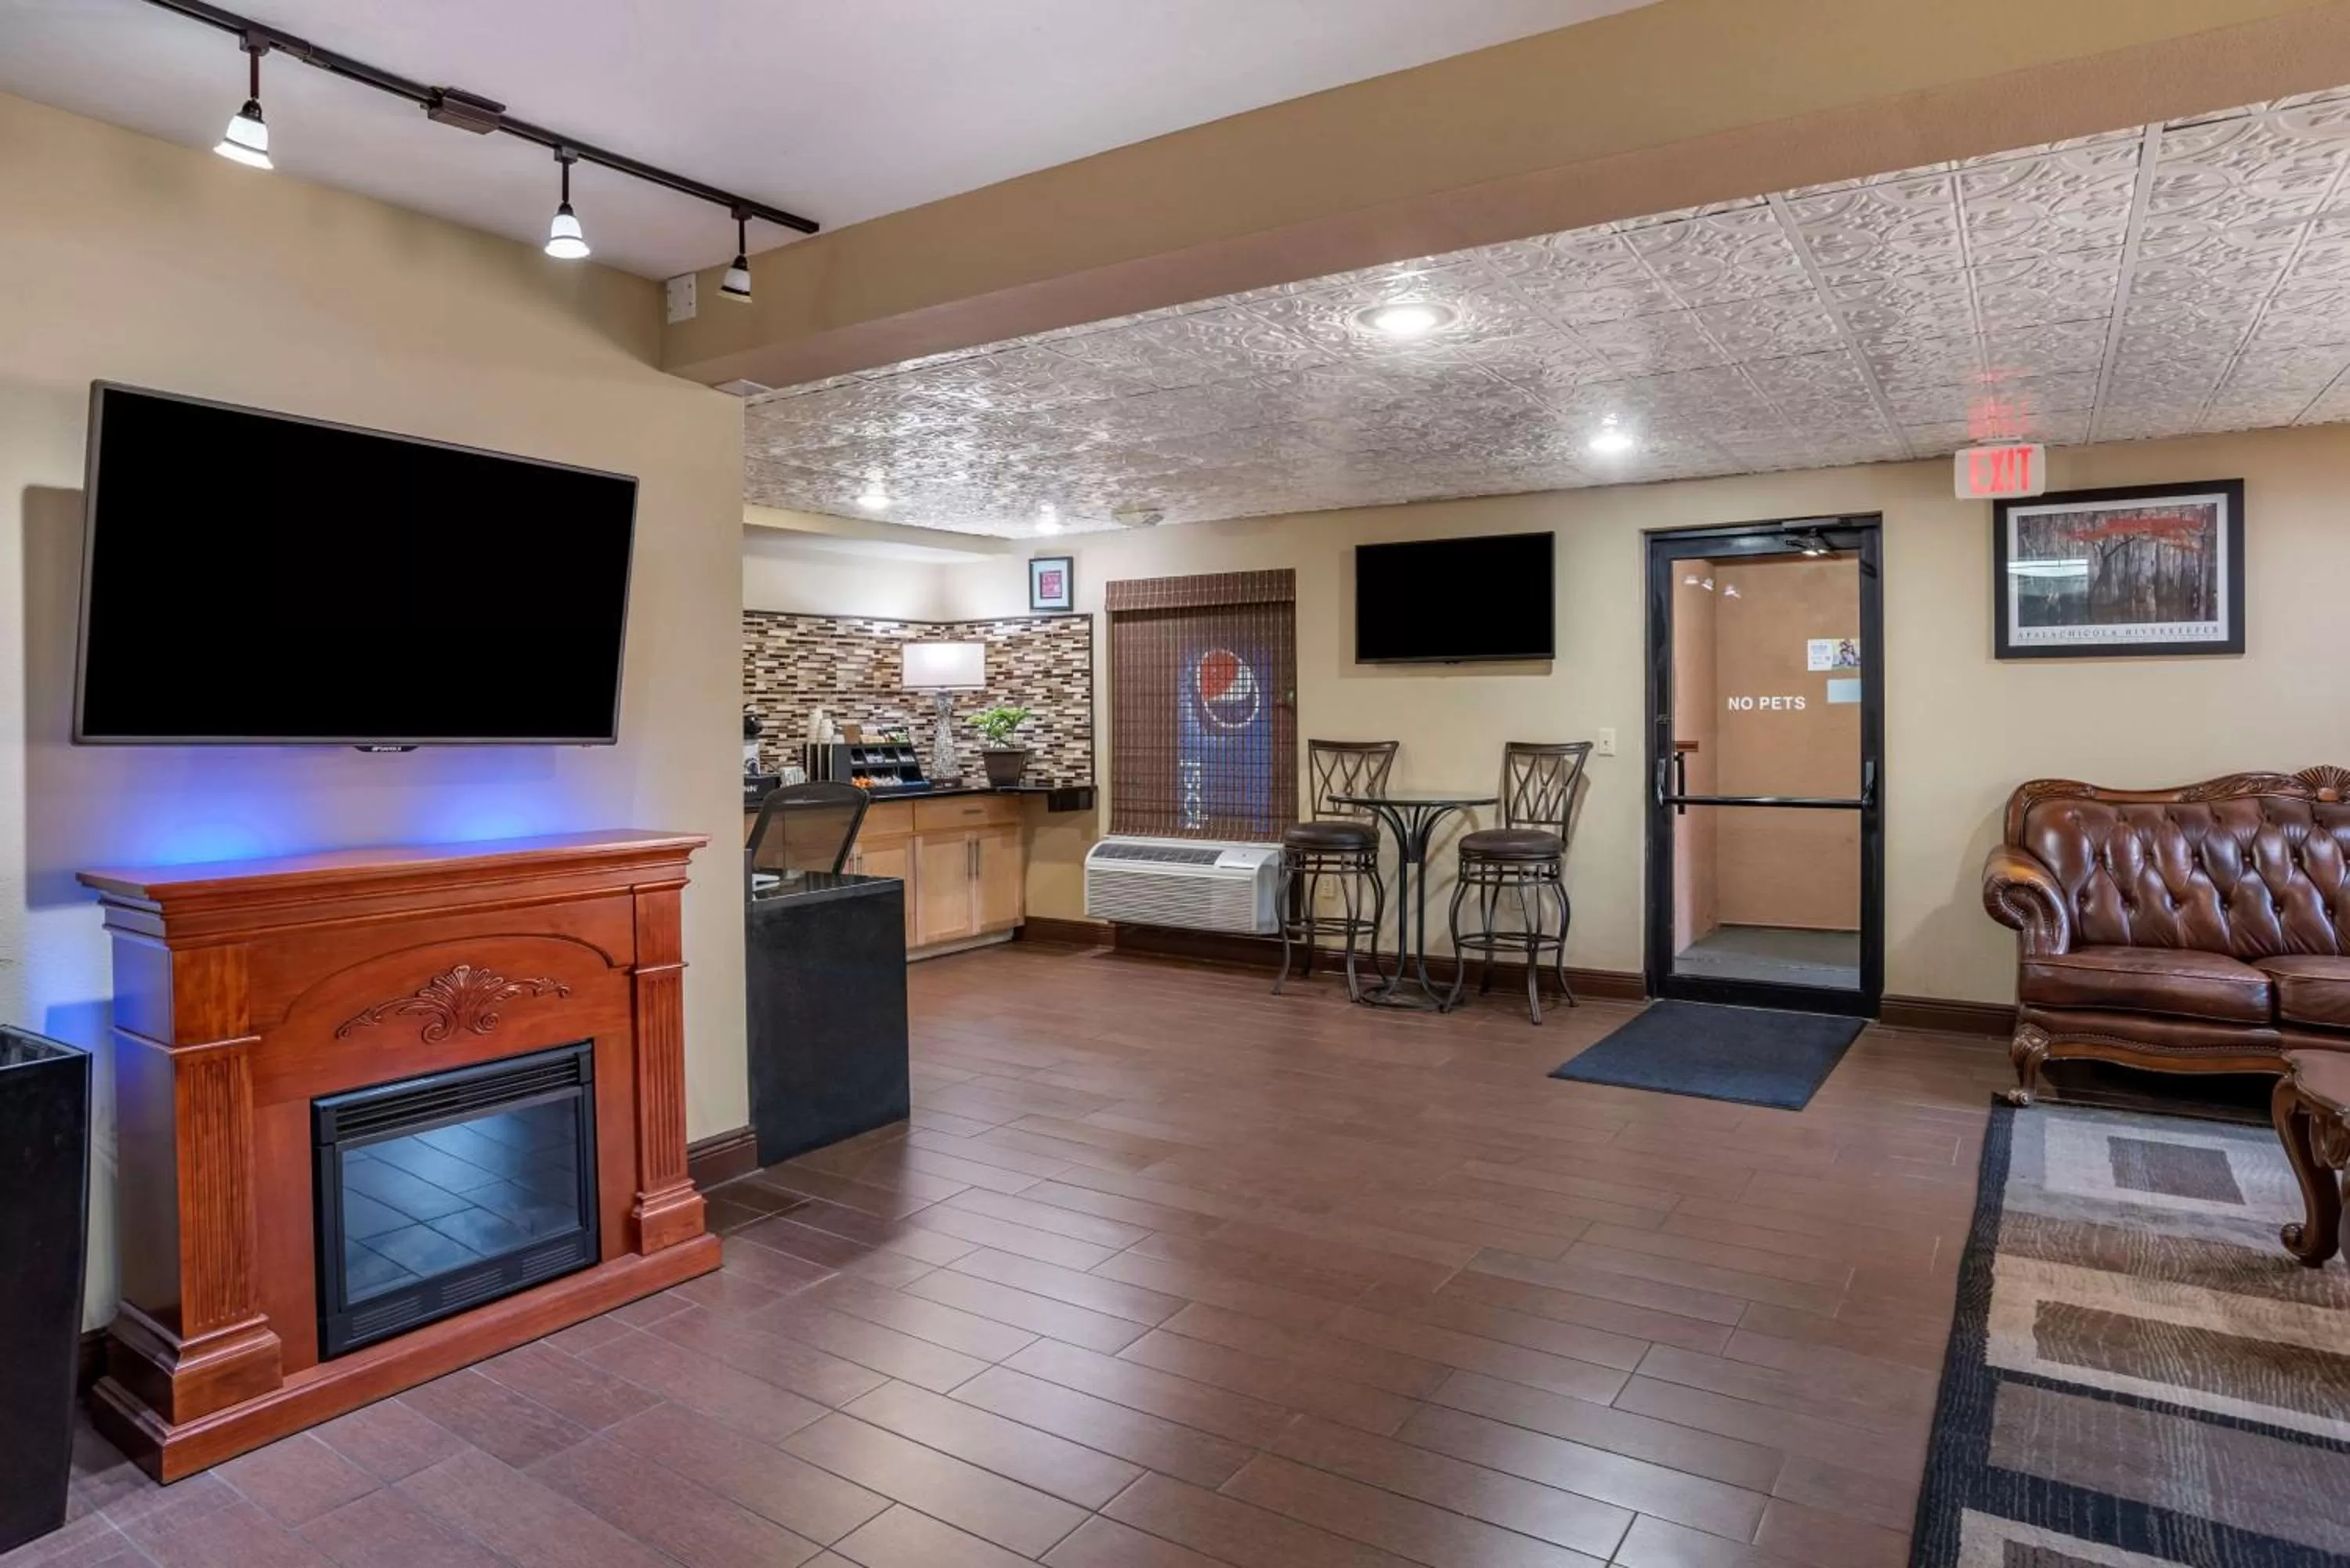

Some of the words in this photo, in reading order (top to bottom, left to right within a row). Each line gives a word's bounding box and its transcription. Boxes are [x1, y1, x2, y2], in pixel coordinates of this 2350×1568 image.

[1969, 446, 2033, 494] EXIT
[1728, 696, 1754, 710] NO
[1759, 695, 1806, 710] PETS
